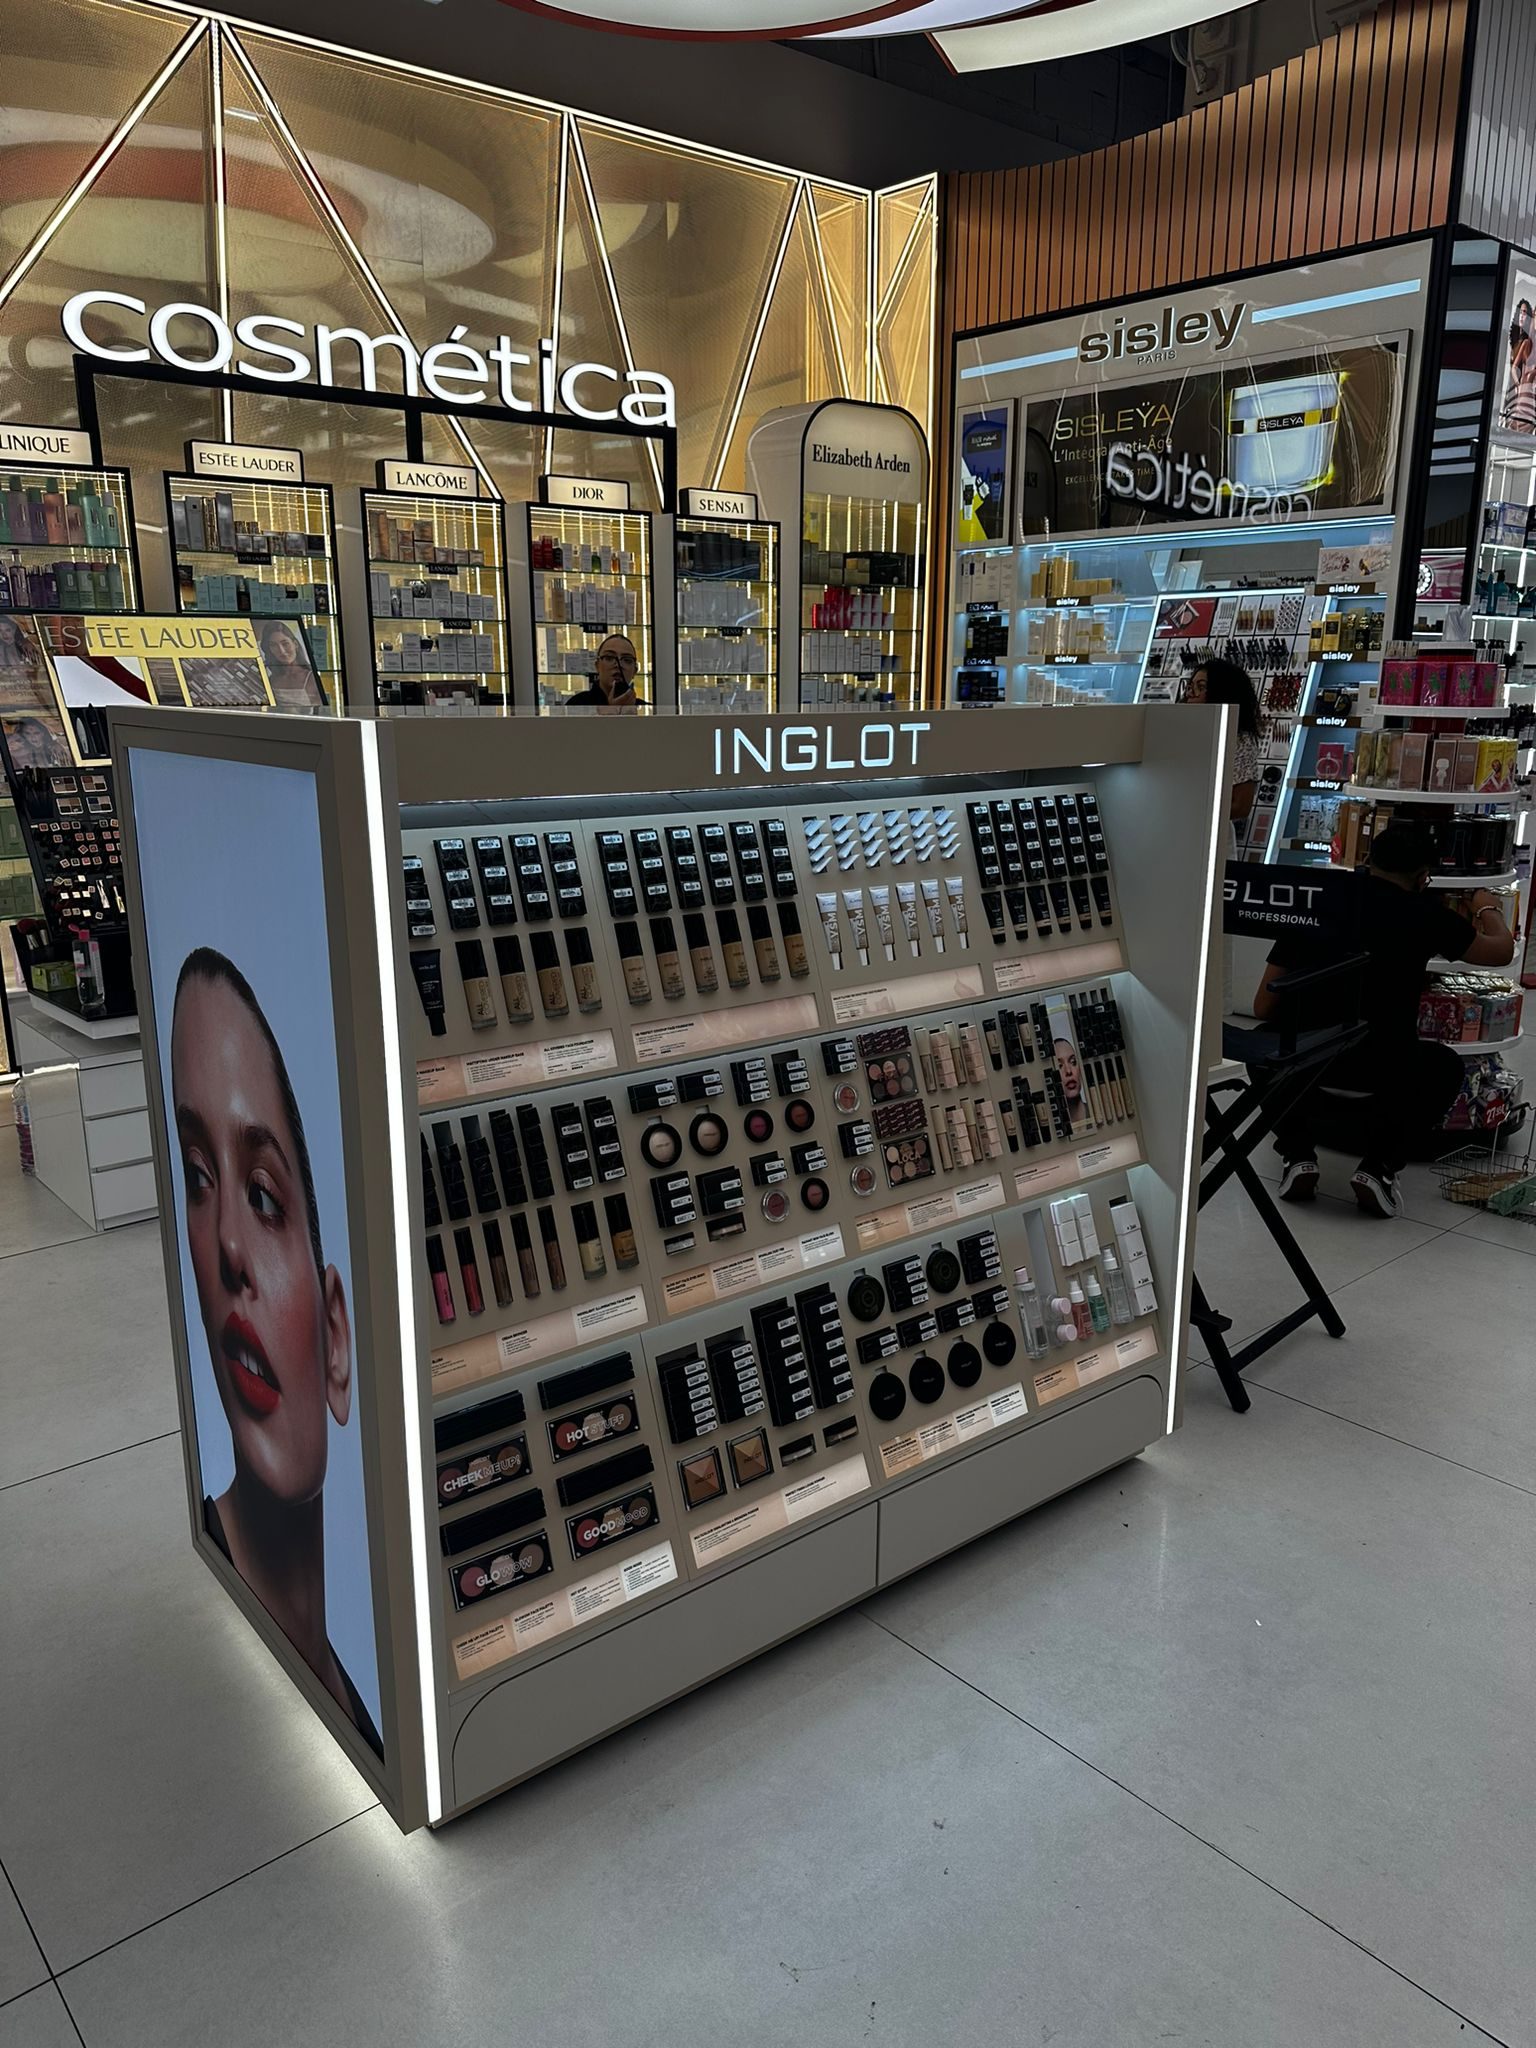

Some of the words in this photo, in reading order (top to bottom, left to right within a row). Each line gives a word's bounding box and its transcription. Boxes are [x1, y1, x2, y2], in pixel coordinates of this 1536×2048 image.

[1079, 303, 1246, 364] sisley
[60, 288, 677, 427] cosmética
[1137, 350, 1176, 365] PARIS
[1055, 401, 1174, 440] SISLEŸA
[242, 456, 295, 473] LAUDER
[812, 444, 873, 469] Elizabeth
[875, 452, 911, 473] Arden
[396, 471, 468, 490] LANCÔME
[572, 486, 604, 501] DIOR
[699, 498, 744, 514] SENSAI
[1328, 584, 1360, 595] sisley
[140, 625, 252, 649] LAUDER
[1321, 652, 1353, 662] sisley
[1316, 717, 1347, 727] sisley
[714, 722, 931, 775] INGLOT
[1309, 779, 1340, 790] sisley
[1238, 909, 1321, 926] PROFESSIONAL
[566, 1425, 590, 1443] HOT
[589, 1413, 625, 1435] STUFF
[443, 1470, 483, 1493] CHEEK
[483, 1462, 501, 1477] ME
[584, 1520, 616, 1541] GOOD
[615, 1506, 648, 1529] MOOD
